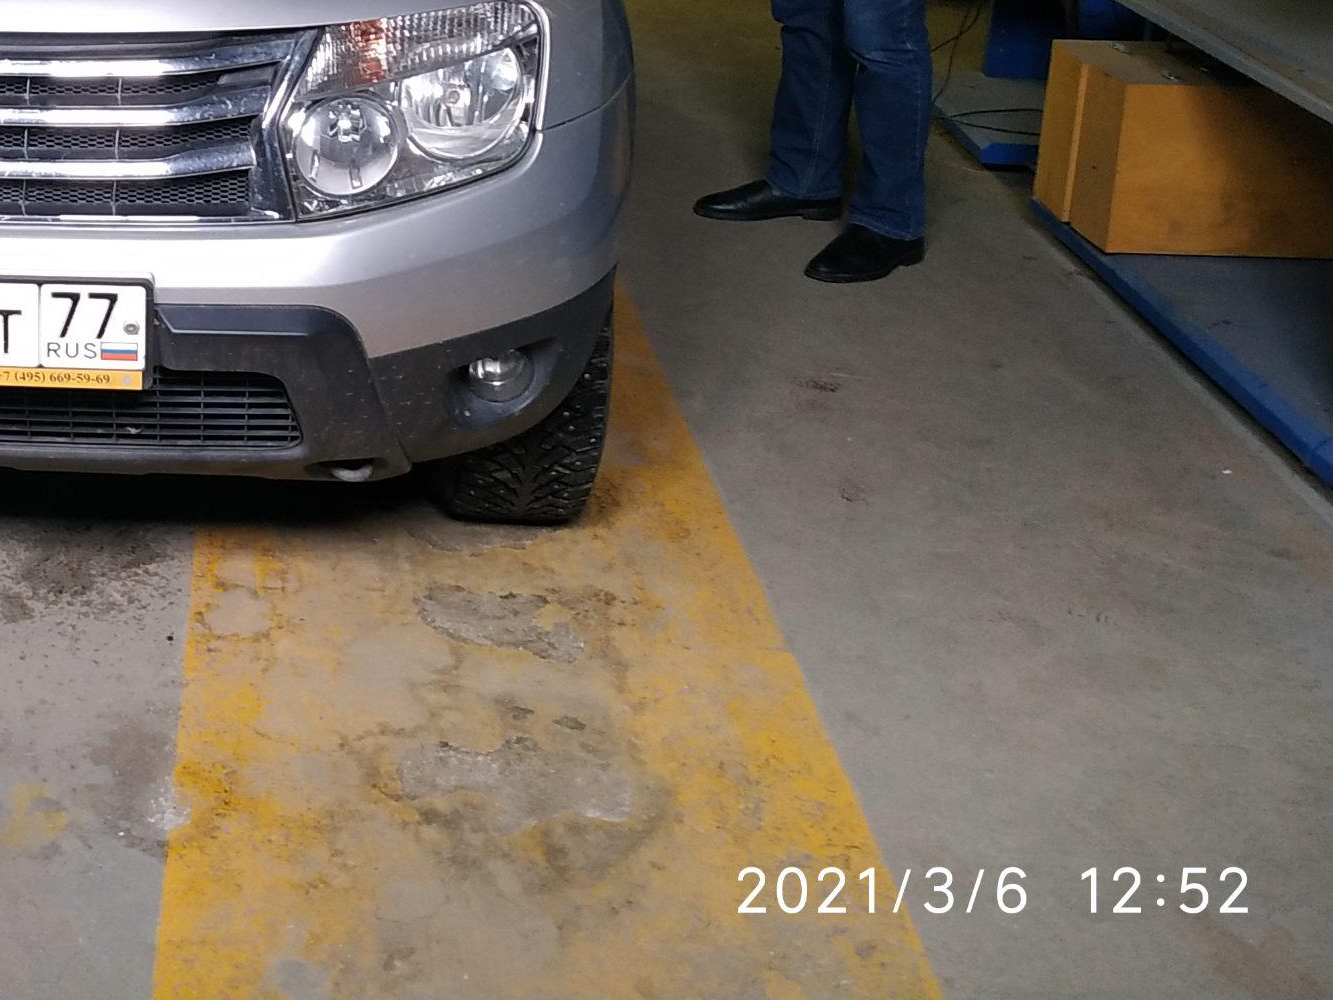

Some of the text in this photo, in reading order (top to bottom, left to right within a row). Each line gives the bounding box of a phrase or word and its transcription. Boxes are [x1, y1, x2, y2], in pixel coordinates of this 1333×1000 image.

[51, 292, 118, 339] 77
[46, 342, 97, 360] RUS
[14, 371, 46, 383] (495)
[49, 373, 111, 384] 669-59-69
